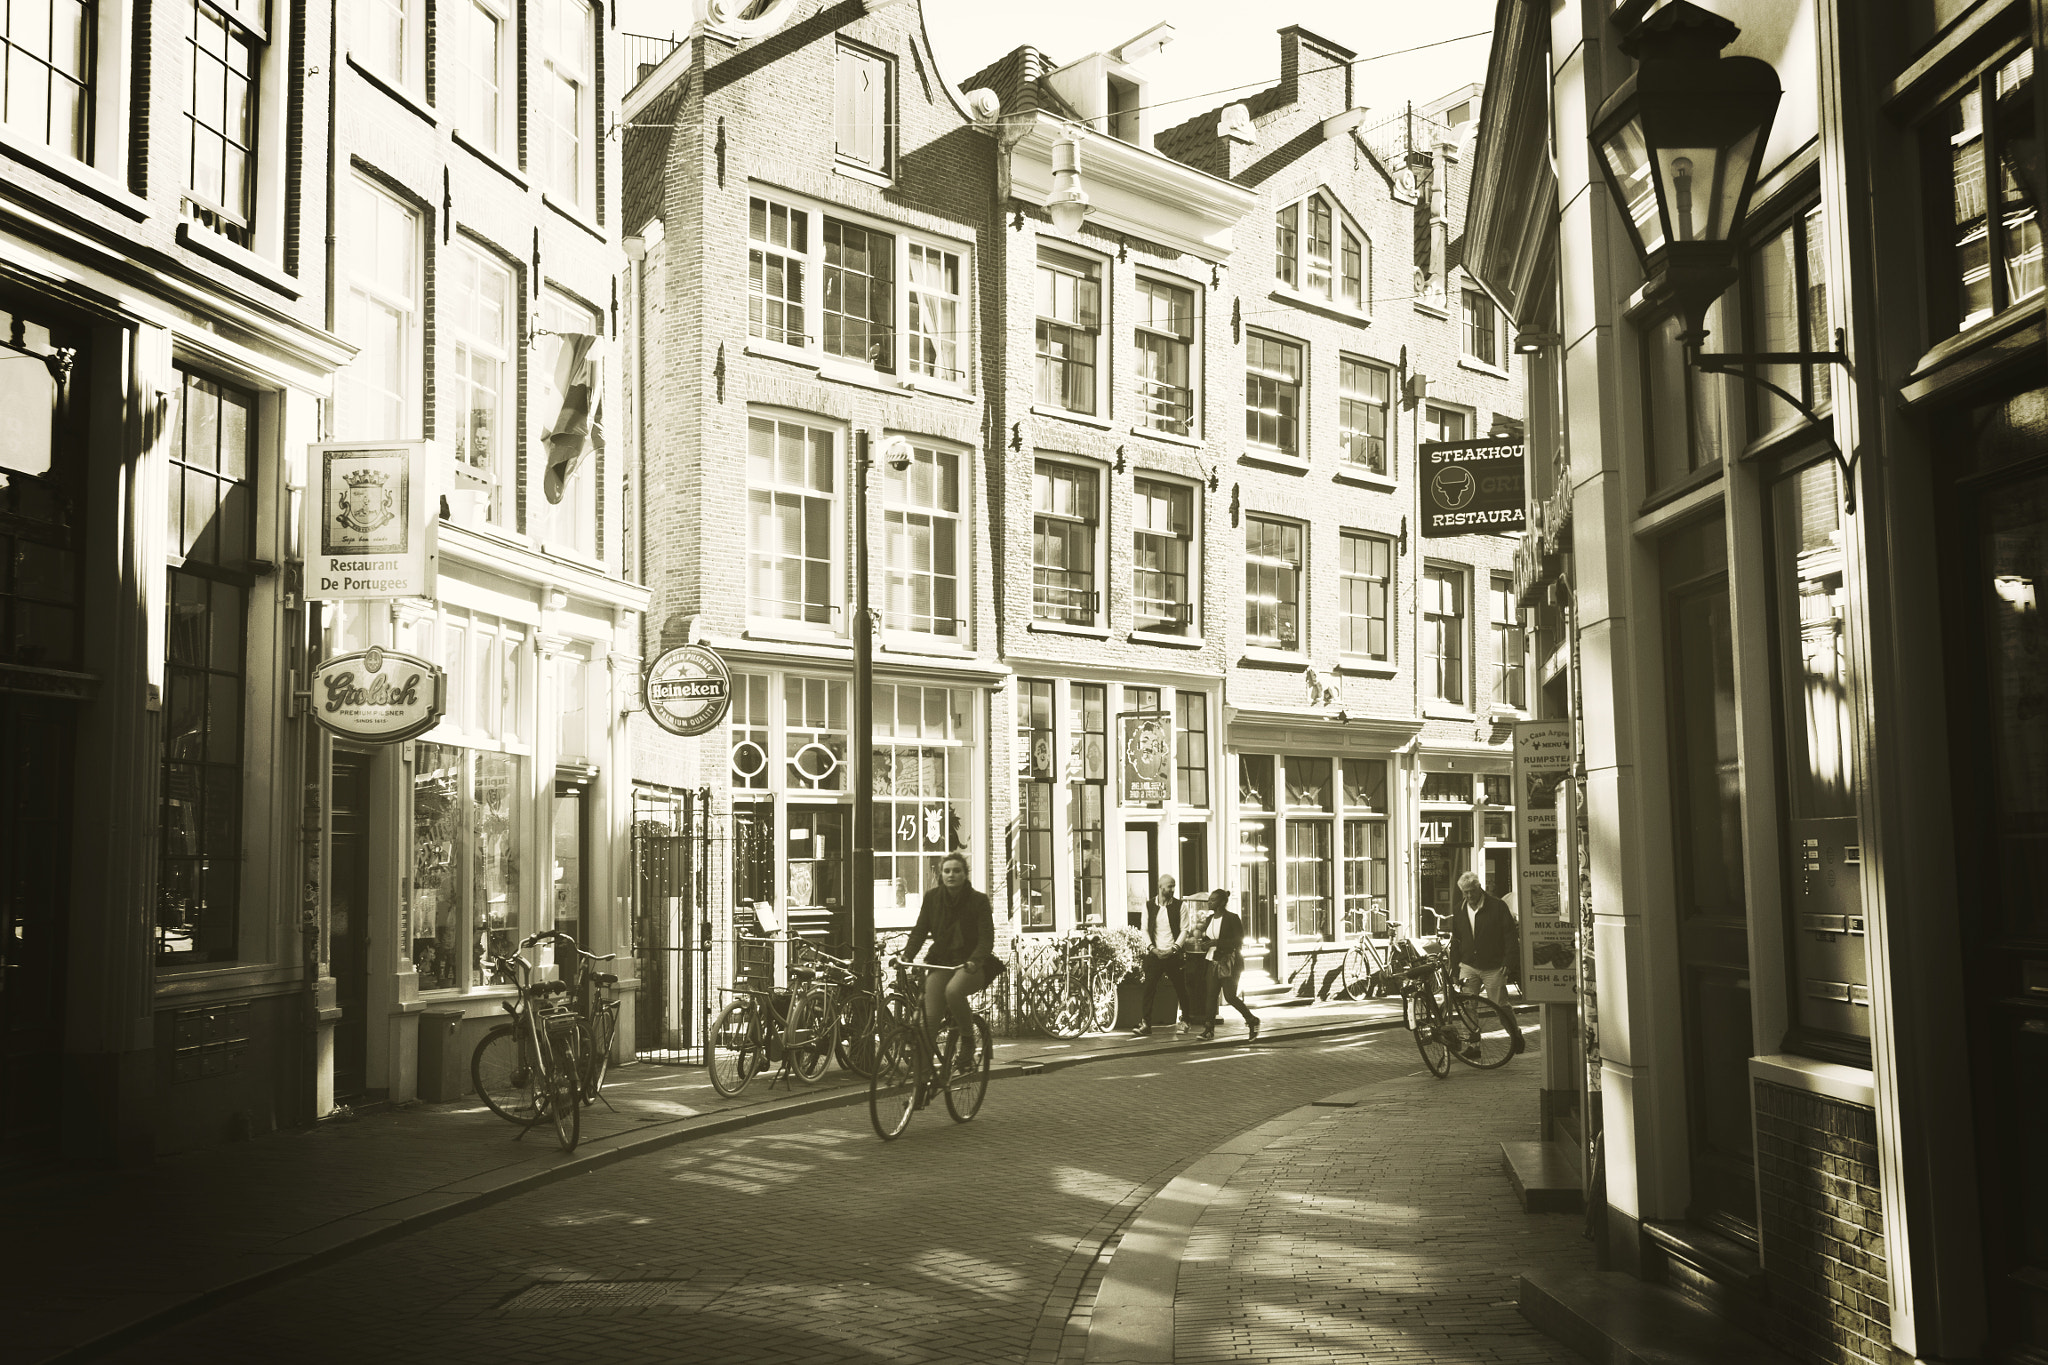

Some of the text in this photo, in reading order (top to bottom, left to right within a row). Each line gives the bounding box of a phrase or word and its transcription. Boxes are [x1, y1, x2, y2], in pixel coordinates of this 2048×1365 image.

[1432, 509, 1525, 527] RESTAURA
[330, 558, 398, 572] Restaurant
[321, 577, 408, 592] De Portugees
[323, 671, 420, 713] Grolsch
[652, 682, 720, 699] Heineken
[659, 704, 717, 727] PREMIUM QUALITY
[1527, 814, 1556, 822] SPARE
[897, 814, 917, 841] 43
[1420, 821, 1453, 842] ZILT
[1529, 974, 1551, 982] FISH
[1553, 974, 1560, 982] &
